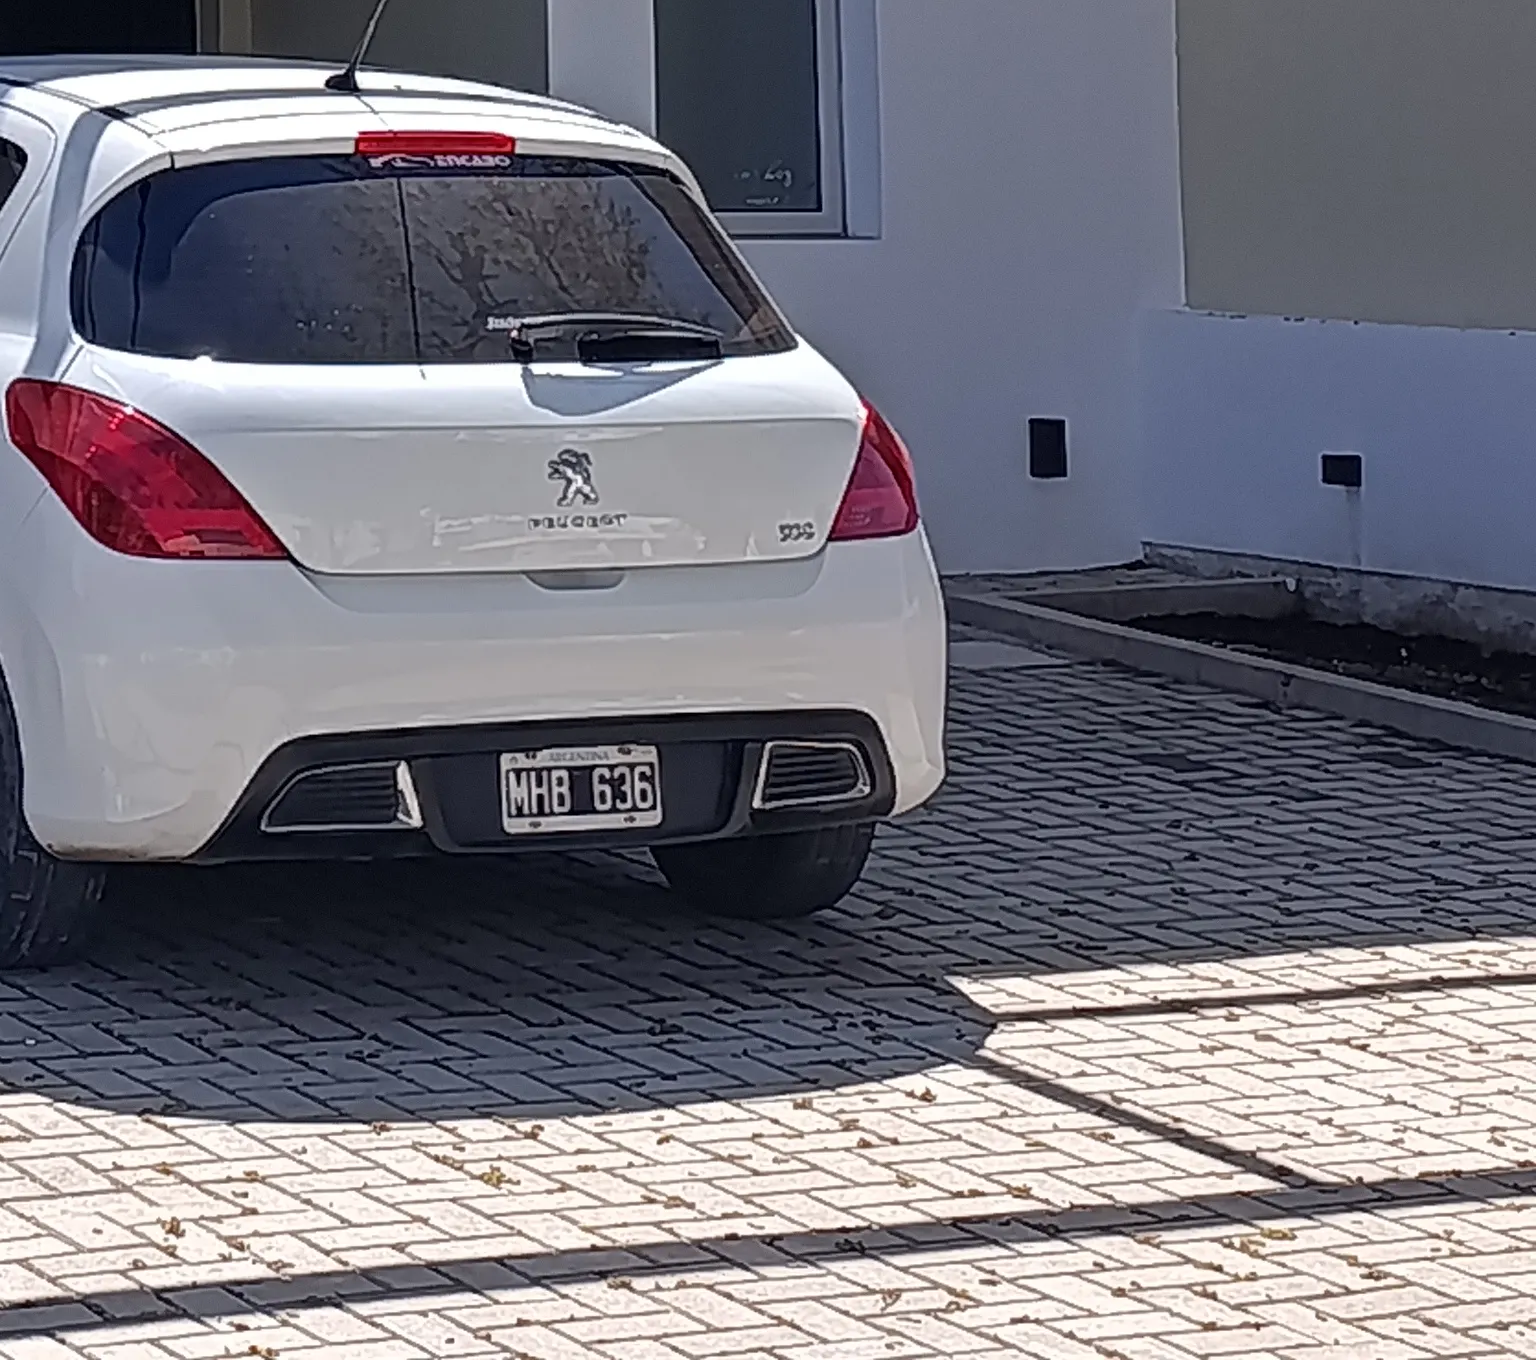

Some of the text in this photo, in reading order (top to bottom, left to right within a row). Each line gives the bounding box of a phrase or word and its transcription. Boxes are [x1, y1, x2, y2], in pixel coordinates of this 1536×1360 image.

[549, 751, 609, 762] ARGENTINA
[509, 766, 654, 816] MHB 636
